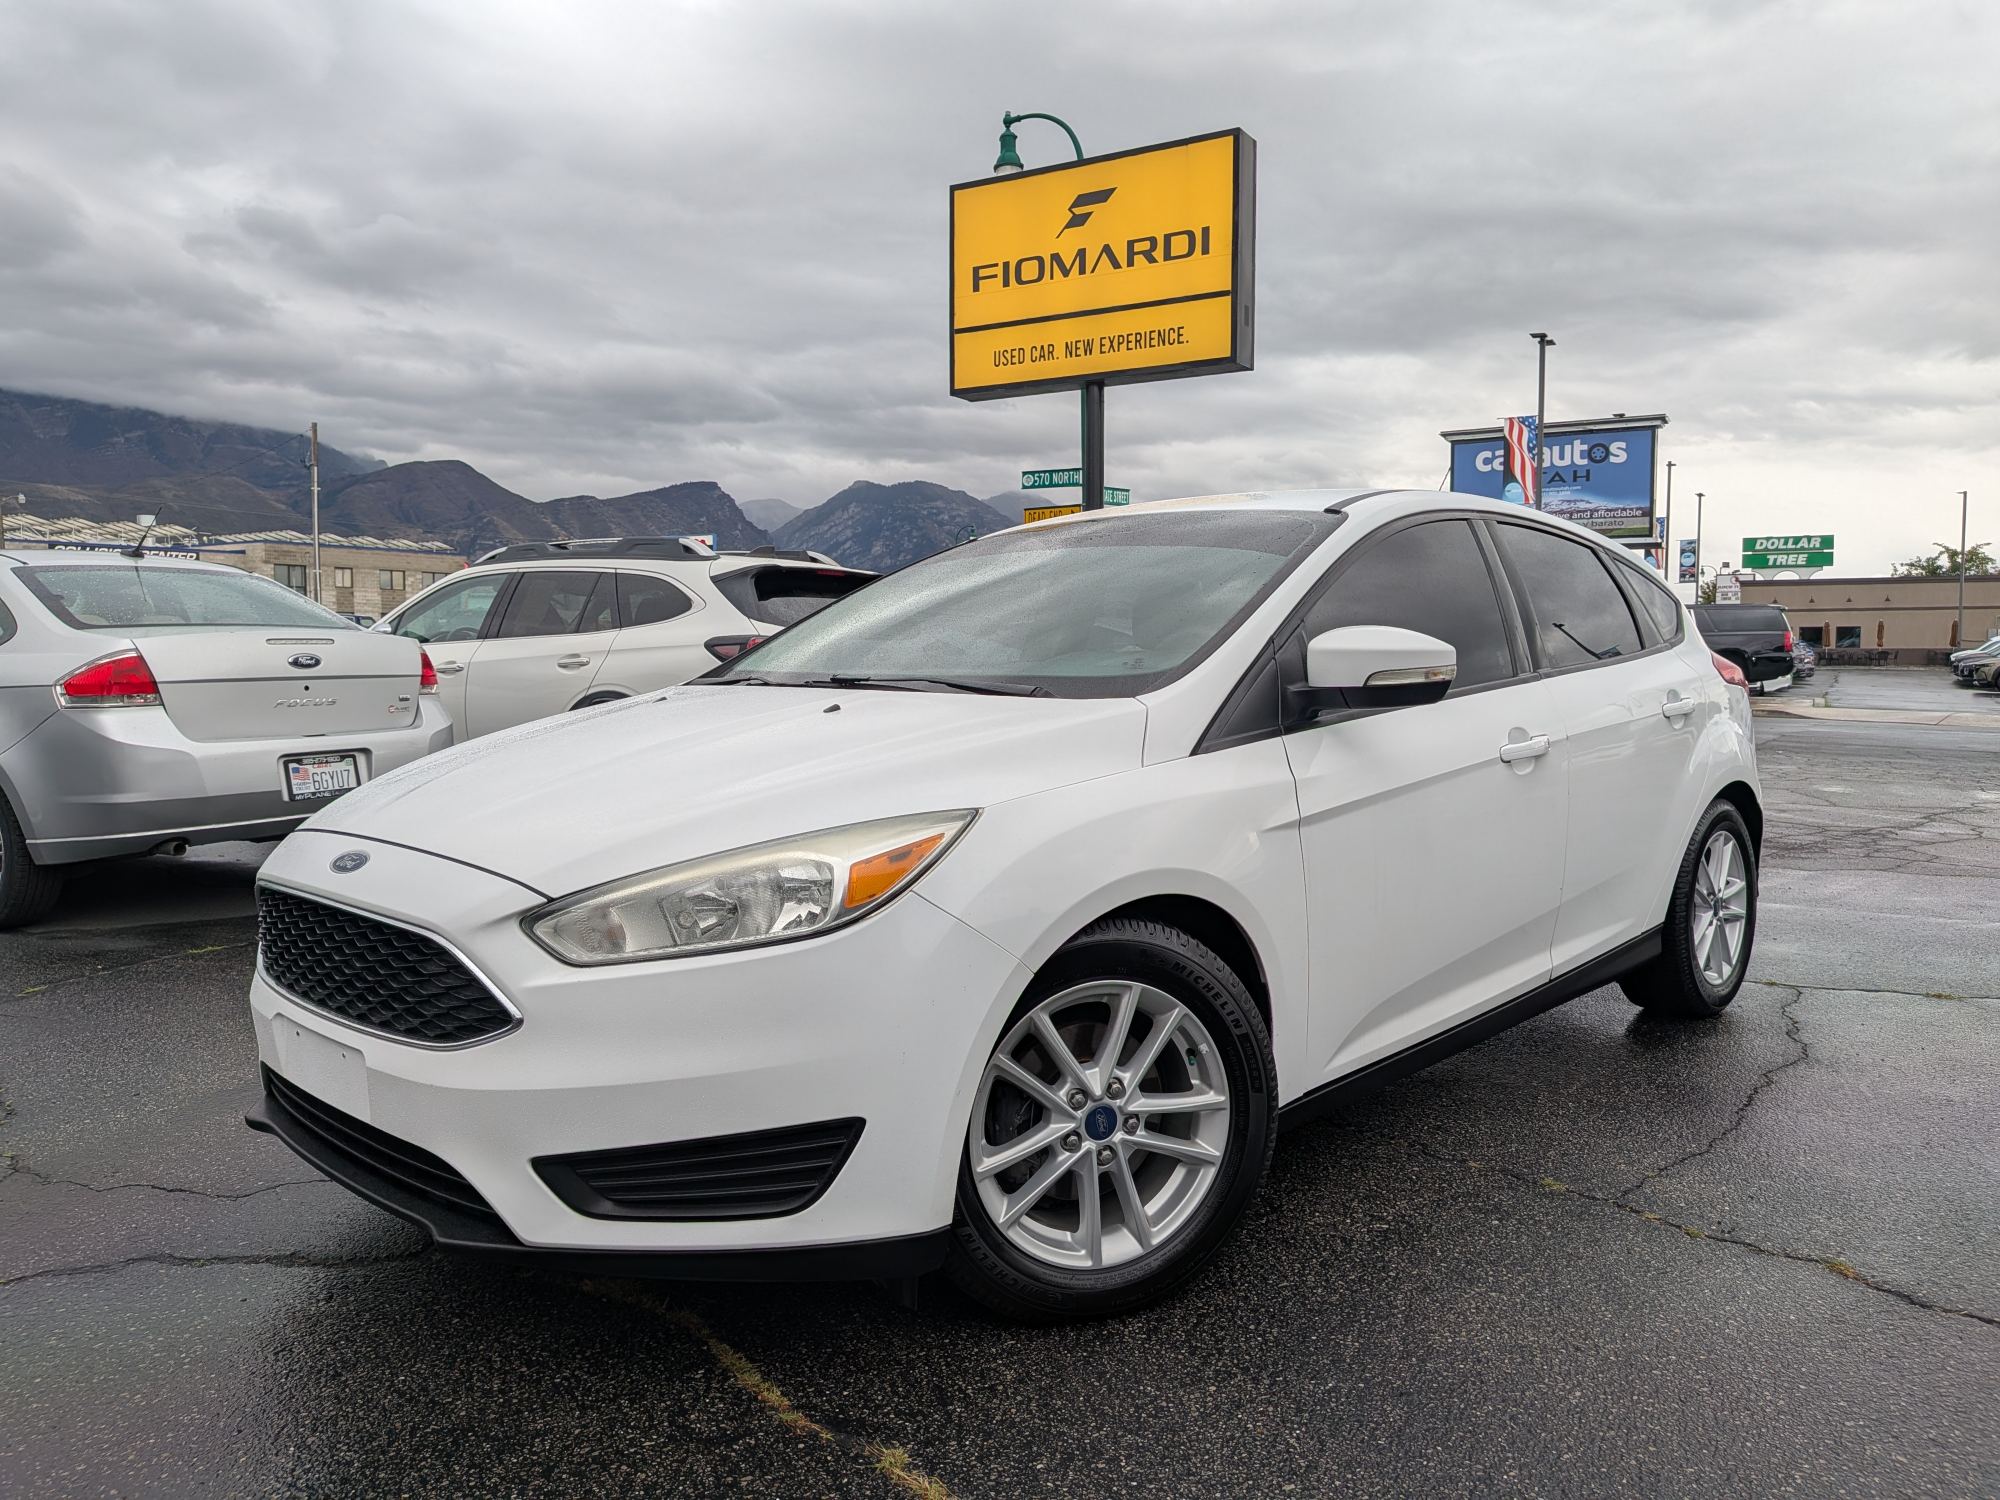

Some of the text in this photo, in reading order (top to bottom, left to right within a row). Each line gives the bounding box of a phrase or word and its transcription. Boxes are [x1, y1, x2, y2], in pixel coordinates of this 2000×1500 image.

[972, 225, 1211, 293] FIOMARDI
[993, 326, 1190, 368] USED CAR. NEW EXPERIENCE.
[1034, 471, 1079, 486] 570 NORTH
[1113, 490, 1129, 504] STREET
[1572, 510, 1590, 519] and
[1592, 508, 1642, 518] affordable
[1591, 519, 1624, 527] barato
[1754, 536, 1821, 550] DOLLAR
[1766, 554, 1808, 566] TREE
[274, 697, 337, 708] FOCUS
[312, 769, 350, 791] 6GYU7
[1170, 960, 1245, 1030] MICHELIN
